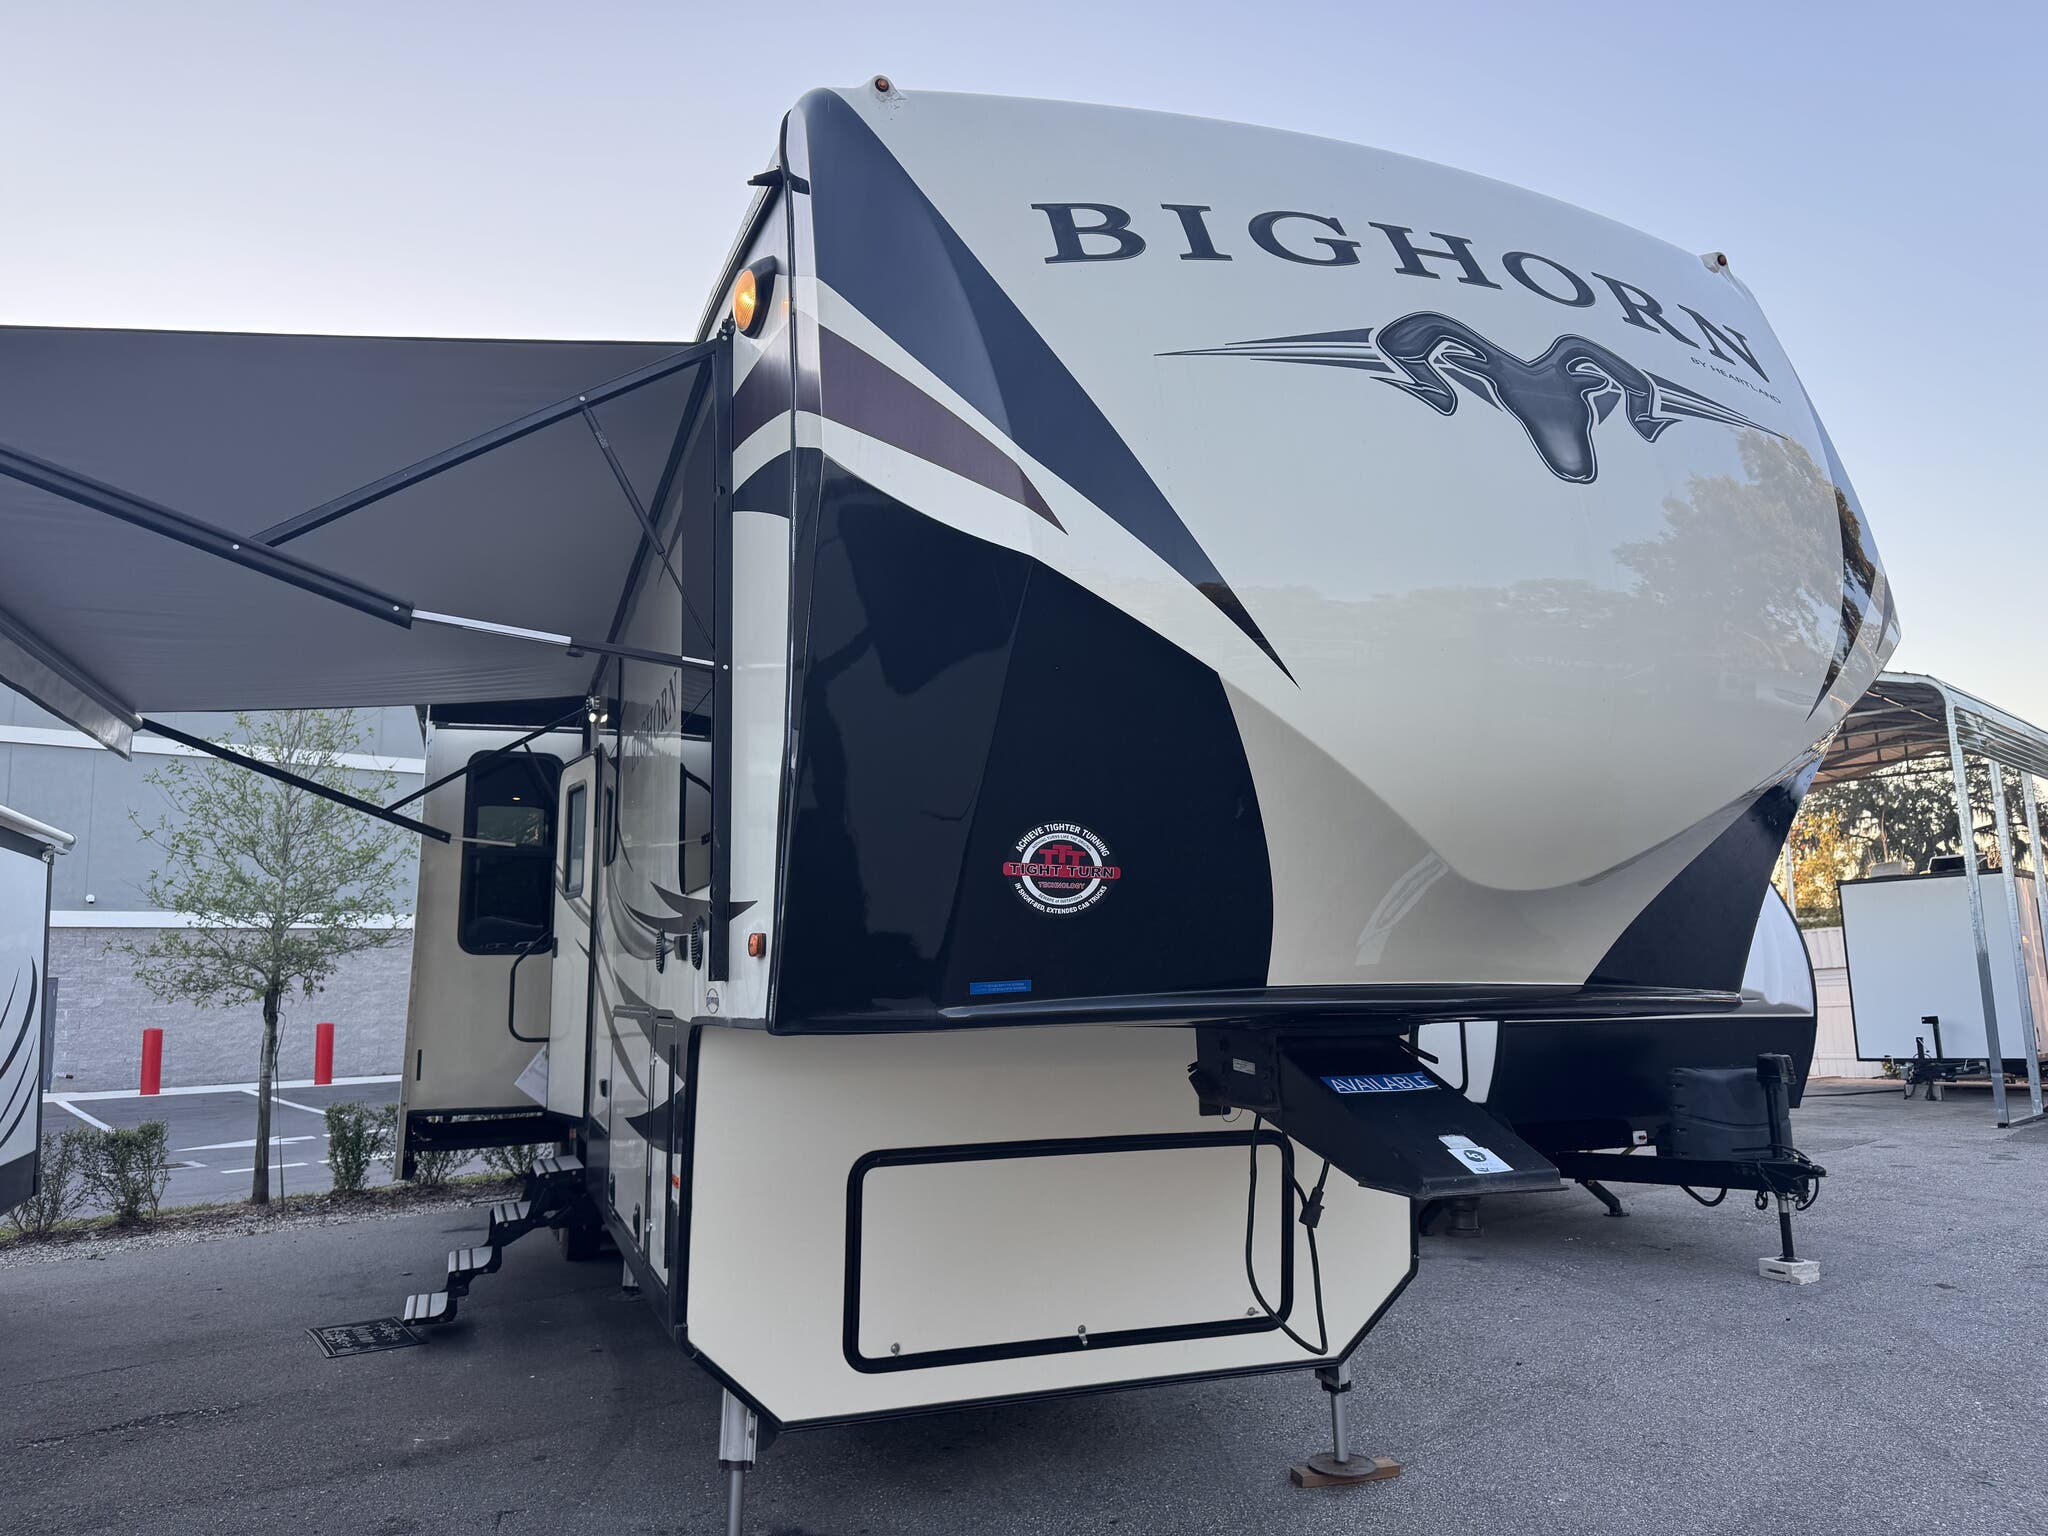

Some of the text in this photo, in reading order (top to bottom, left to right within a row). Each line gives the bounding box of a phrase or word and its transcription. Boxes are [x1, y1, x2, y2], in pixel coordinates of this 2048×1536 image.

[1031, 202, 1770, 383] BIGHORN
[1710, 364, 1782, 404] HEARTLAND
[1015, 823, 1110, 857] ACHIEVE TIGHTER TURNING
[1009, 863, 1115, 878] TIGHT TURN
[1038, 881, 1086, 890] TECHNOLOGY
[1014, 882, 1022, 890] IN
[1046, 906, 1078, 915] EXTENDED
[1077, 901, 1090, 911] CAB
[1088, 885, 1108, 904] TRUCKS
[1330, 1074, 1430, 1093] AVAILABLE
